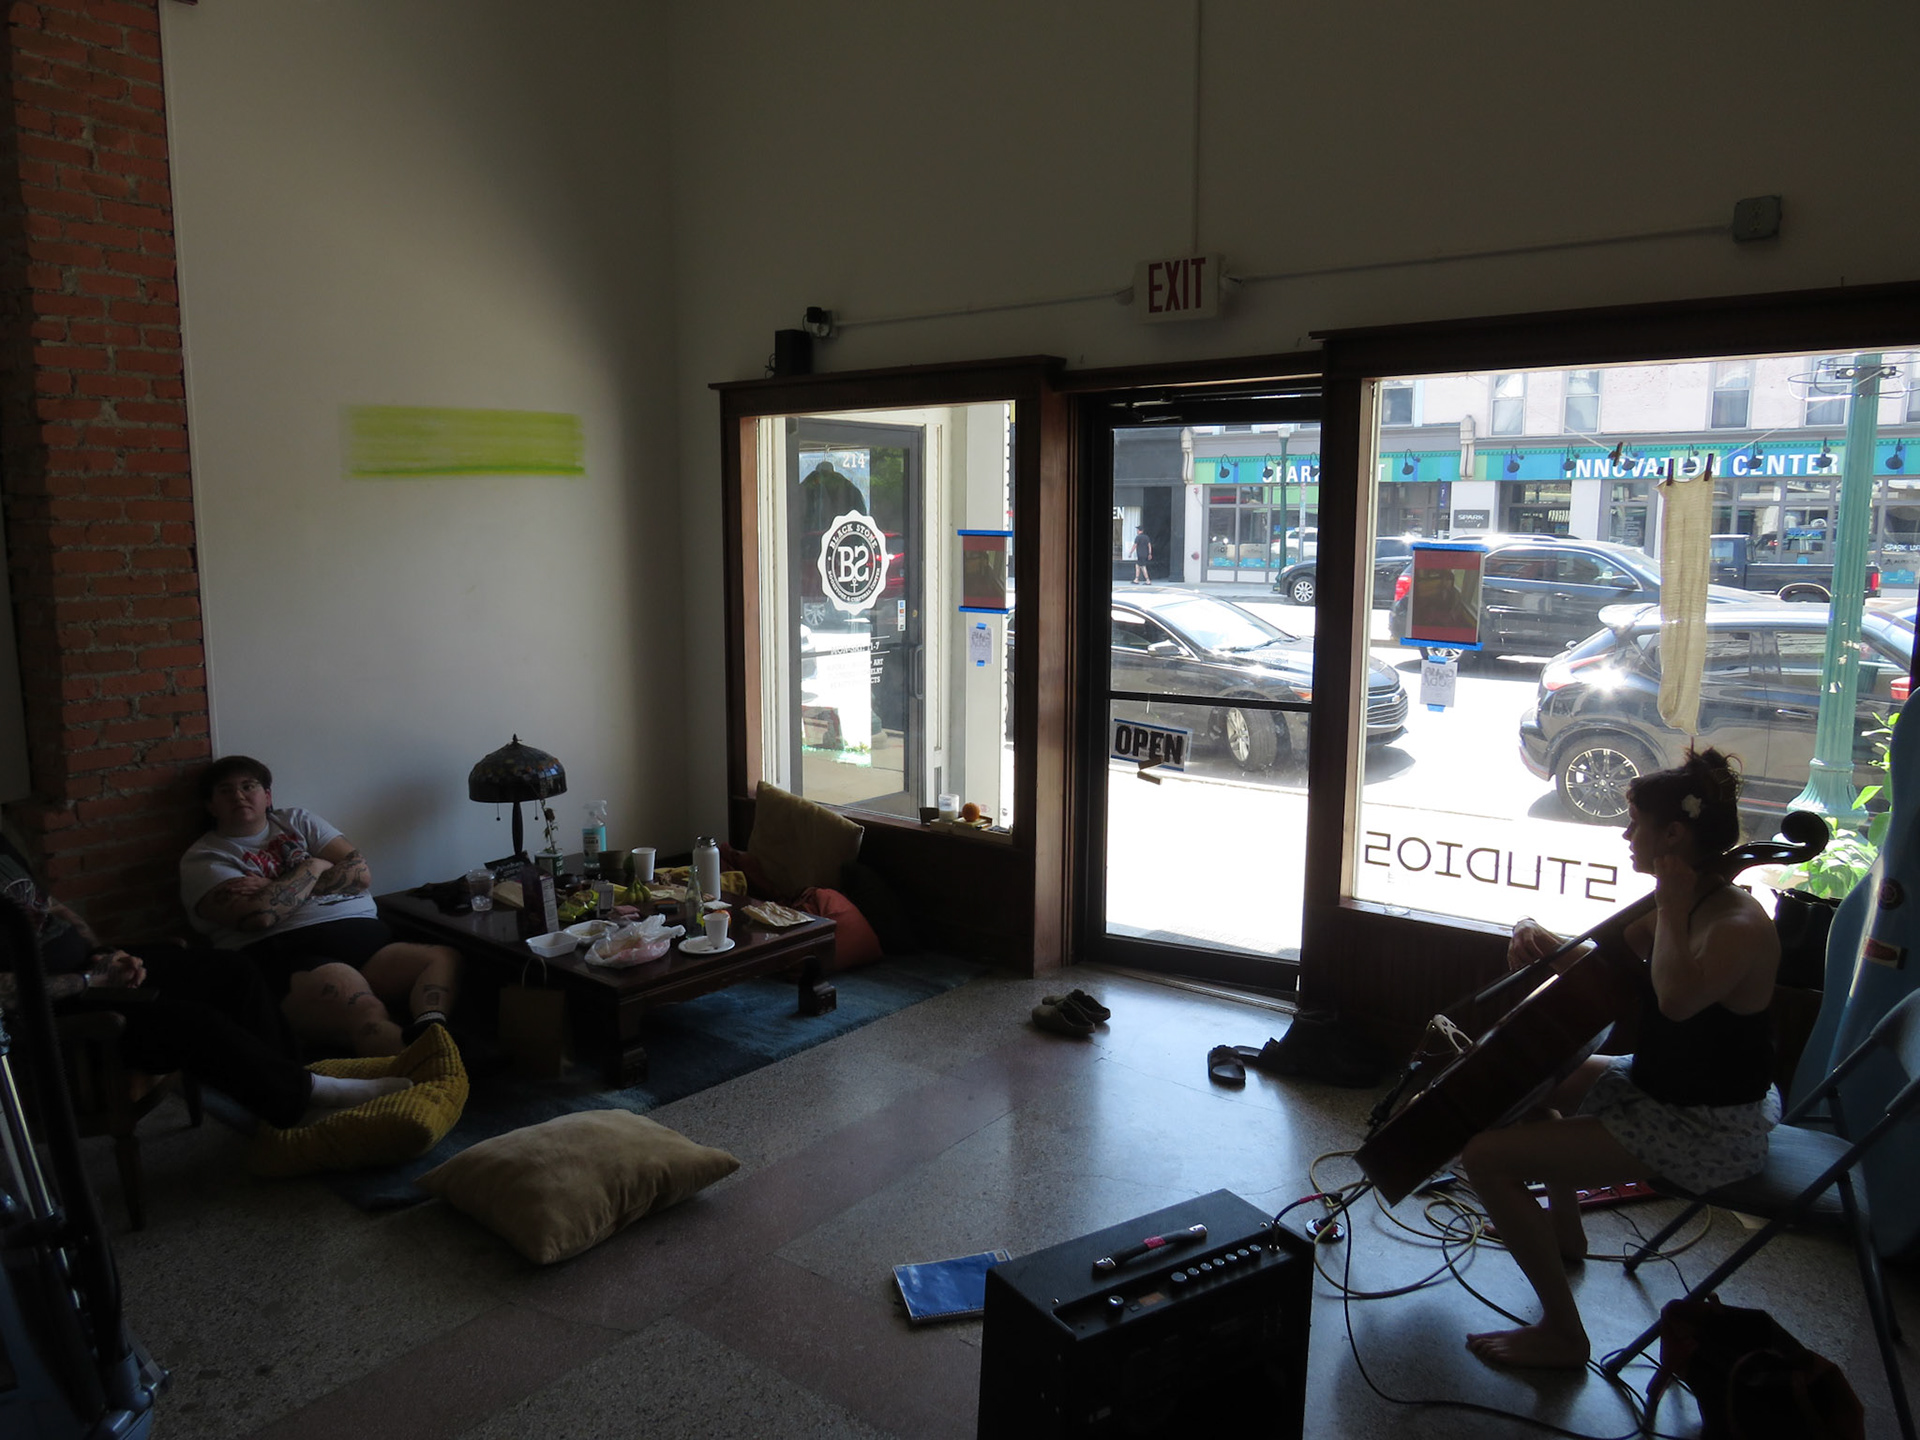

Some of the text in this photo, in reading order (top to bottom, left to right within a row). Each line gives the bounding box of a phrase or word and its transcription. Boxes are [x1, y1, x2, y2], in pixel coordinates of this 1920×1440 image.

[1148, 256, 1206, 313] EXIT
[842, 453, 865, 469] 214
[1733, 453, 1839, 476] CENTER
[829, 523, 878, 550] BLACK STONE
[1115, 724, 1184, 765] OPEN
